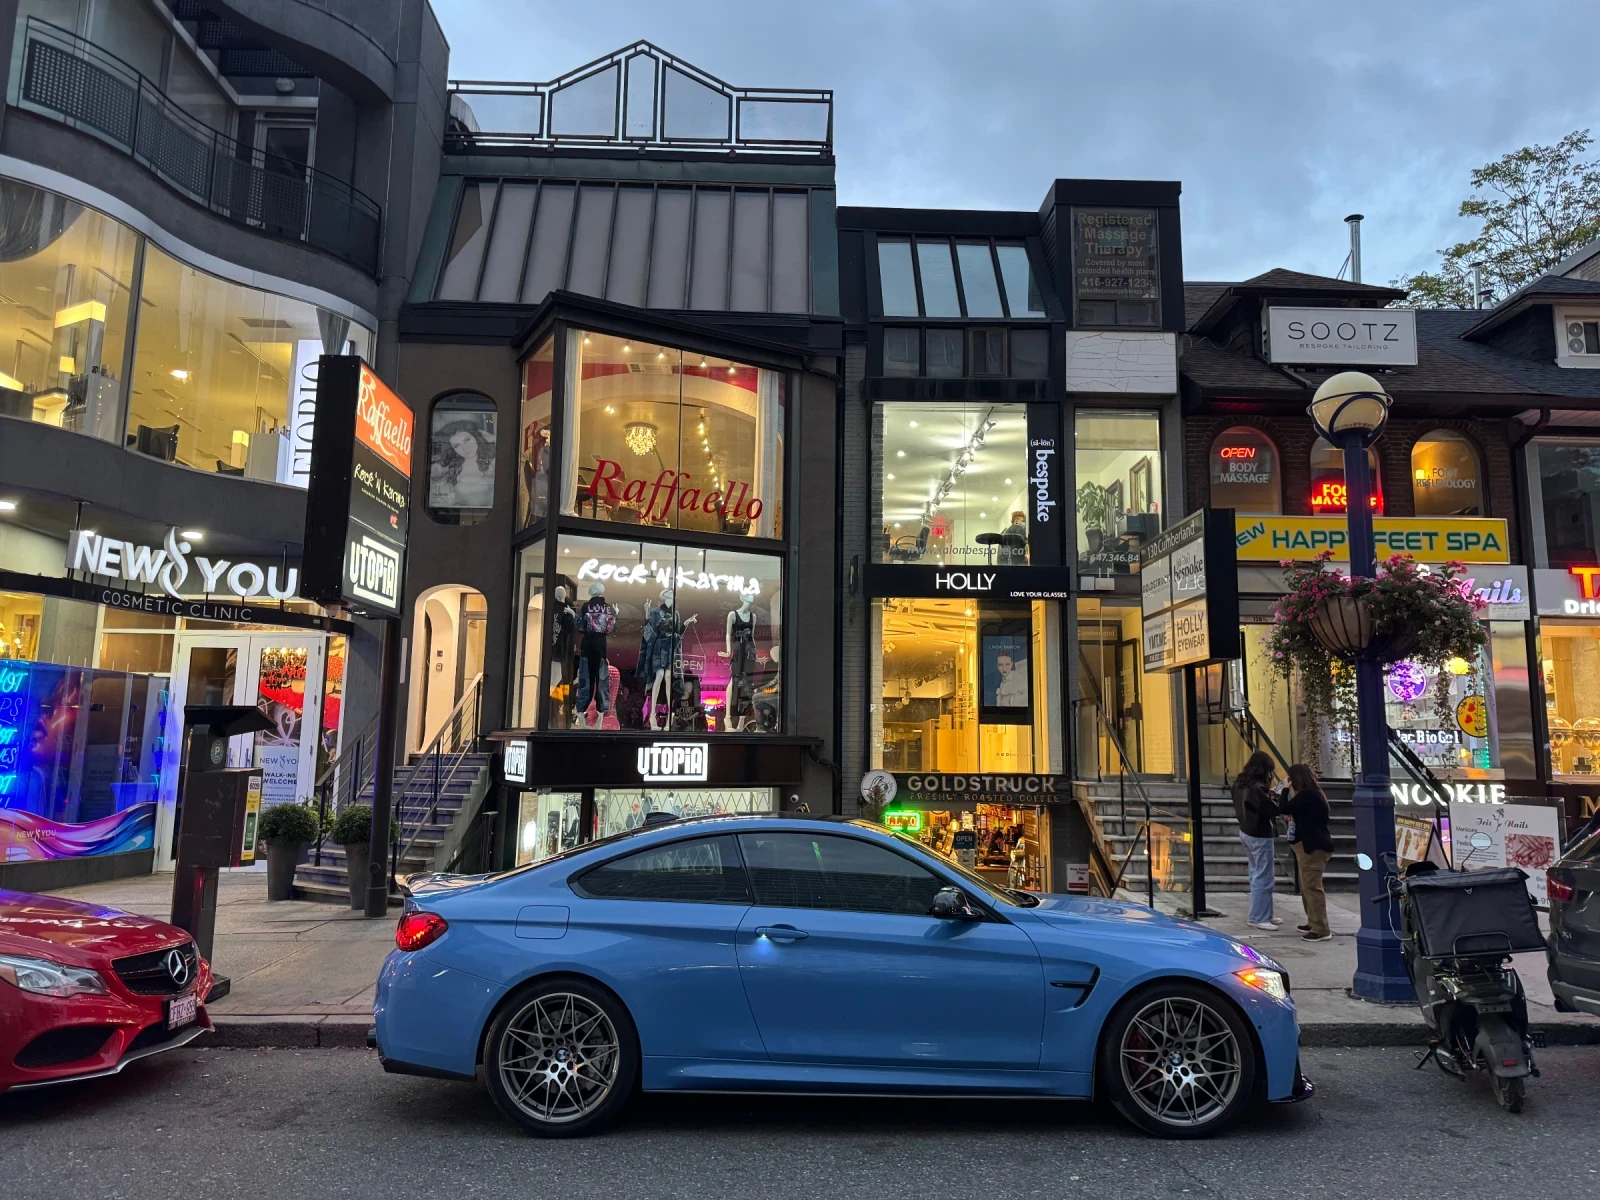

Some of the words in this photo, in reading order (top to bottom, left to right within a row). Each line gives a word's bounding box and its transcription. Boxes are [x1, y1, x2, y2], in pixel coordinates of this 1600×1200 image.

[1077, 213, 1151, 227] Registered
[1084, 228, 1146, 242] Massage
[1085, 242, 1143, 257] Therapy
[1085, 258, 1115, 266] Covered
[1117, 259, 1126, 267] by
[1112, 267, 1134, 275] health
[1136, 268, 1156, 276] plans
[1082, 278, 1153, 287] 416-927-1234
[1288, 321, 1399, 341] SOOTZ
[357, 382, 411, 455] Raffaello
[1220, 447, 1255, 458] OPEN
[1229, 462, 1258, 472] BODY
[1432, 468, 1459, 478] FOOT
[1220, 473, 1269, 483] MASSAGE
[1416, 479, 1476, 489] REFLEXOLOGY
[586, 458, 763, 521] Raffaello
[1030, 449, 1056, 522] bespoke
[1147, 542, 1157, 559] 130
[1157, 520, 1195, 552] Cumberland
[1272, 530, 1349, 549] HAPP
[1373, 532, 1438, 550] FEET
[1446, 532, 1502, 551] SPA
[906, 545, 1024, 557] www.salonbespoke.ca
[1090, 553, 1139, 562] 647.346.84
[66, 530, 167, 584] NEW
[194, 556, 298, 600] YOU
[1174, 555, 1203, 582] bespoke
[936, 573, 997, 590] HOLLY
[1570, 566, 1600, 599] T
[102, 590, 183, 615] COSMETIC
[189, 604, 252, 621] CLINIC
[1177, 612, 1204, 638] HOLLY
[1177, 633, 1205, 652] EYEWEAR
[675, 660, 703, 671] OPEN
[260, 757, 279, 765] NEW
[907, 776, 1055, 793] GOLDSTRUCK
[910, 792, 957, 800] FRESHLY
[964, 793, 1012, 802] ROASTED
[1019, 794, 1060, 803] COFFEE
[1476, 818, 1492, 826] Iris
[1505, 820, 1528, 829] Nails
